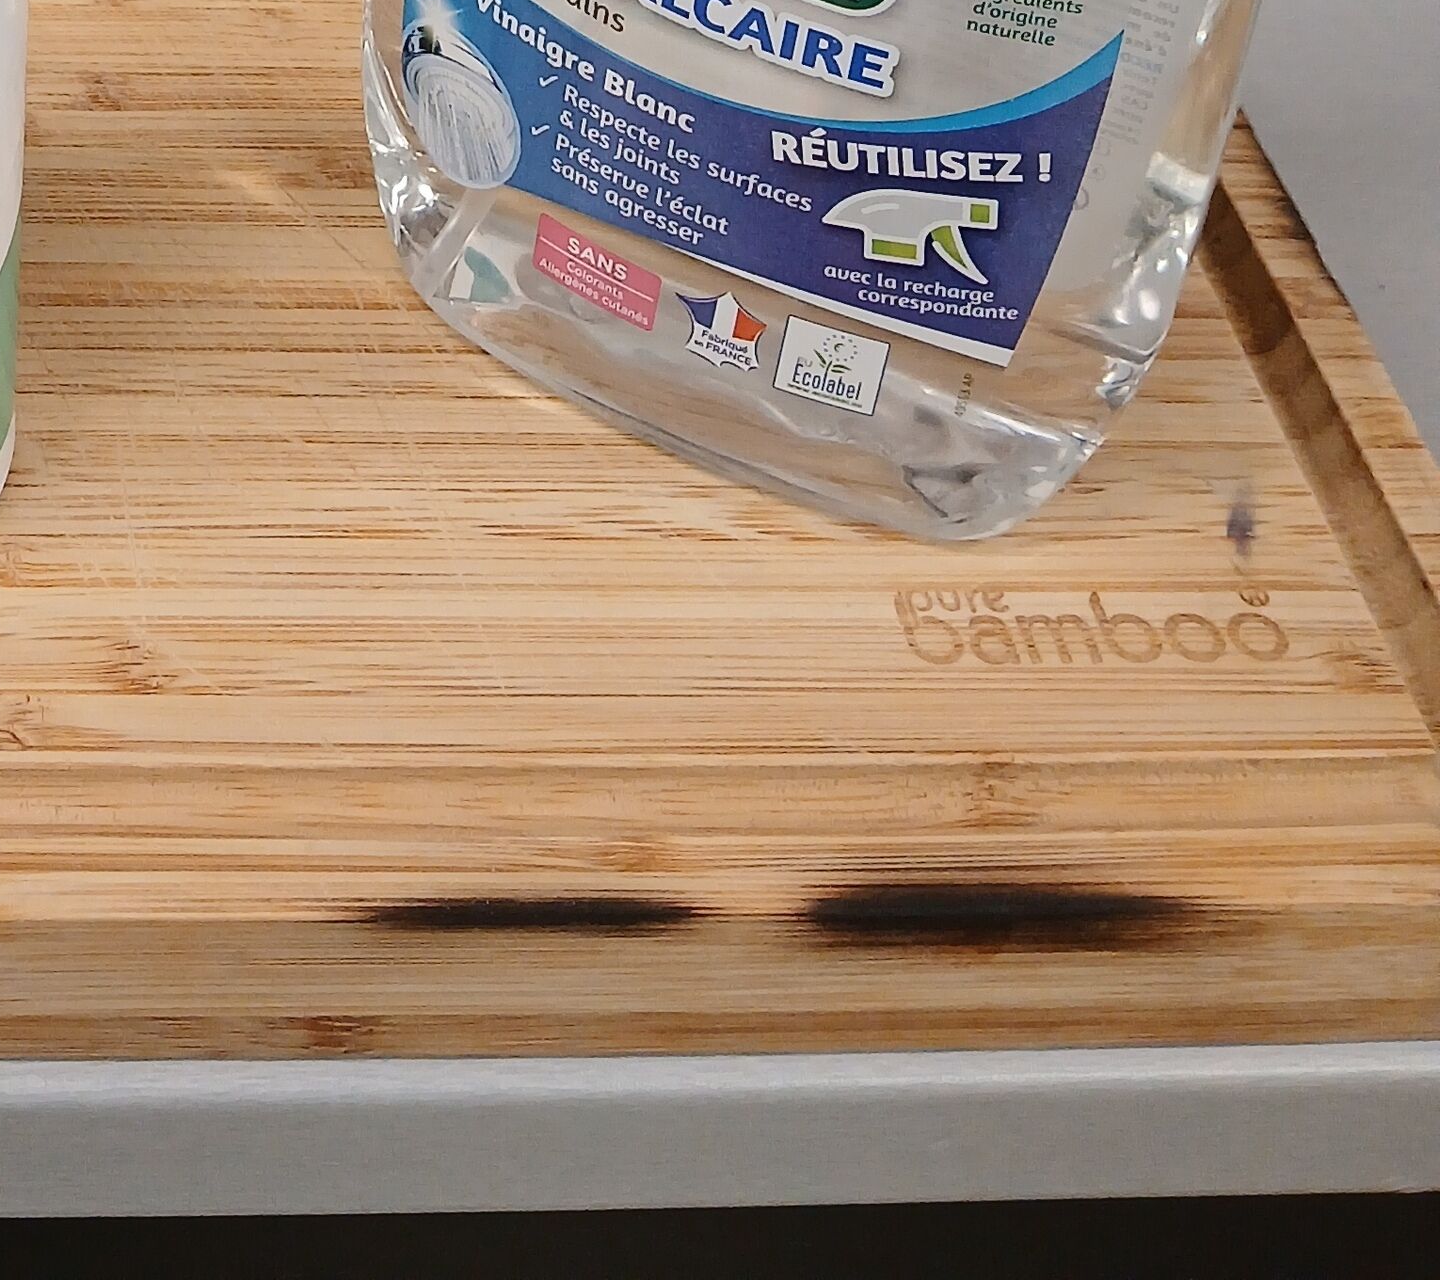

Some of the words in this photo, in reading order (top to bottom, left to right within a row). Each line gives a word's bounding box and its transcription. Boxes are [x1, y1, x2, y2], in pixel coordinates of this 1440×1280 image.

[965, 18, 1056, 46] naturelle
[973, 1, 1059, 30] d'origine
[603, 68, 697, 134] Blanc
[559, 109, 574, 129] &
[580, 118, 610, 150] les
[613, 137, 681, 186] joints
[563, 83, 661, 151] Respecte
[666, 139, 701, 170] les
[706, 161, 813, 212] surfaces
[771, 127, 1023, 183] RÉUTILISEZ
[551, 157, 600, 196] sans
[605, 188, 705, 246] agresser
[554, 132, 651, 198] Préserve
[655, 186, 729, 236] l'éclat
[566, 237, 628, 281] SANS
[539, 257, 600, 303] Allergènes
[601, 294, 649, 327] cutanés
[566, 260, 624, 303] Colorants
[823, 263, 871, 286] avec
[876, 271, 897, 291] la
[902, 279, 995, 305] recharge
[857, 288, 1019, 321] correspondante
[700, 328, 750, 356] Fabriqué
[704, 341, 754, 368] FRANCE
[792, 361, 862, 401] Ecolabel
